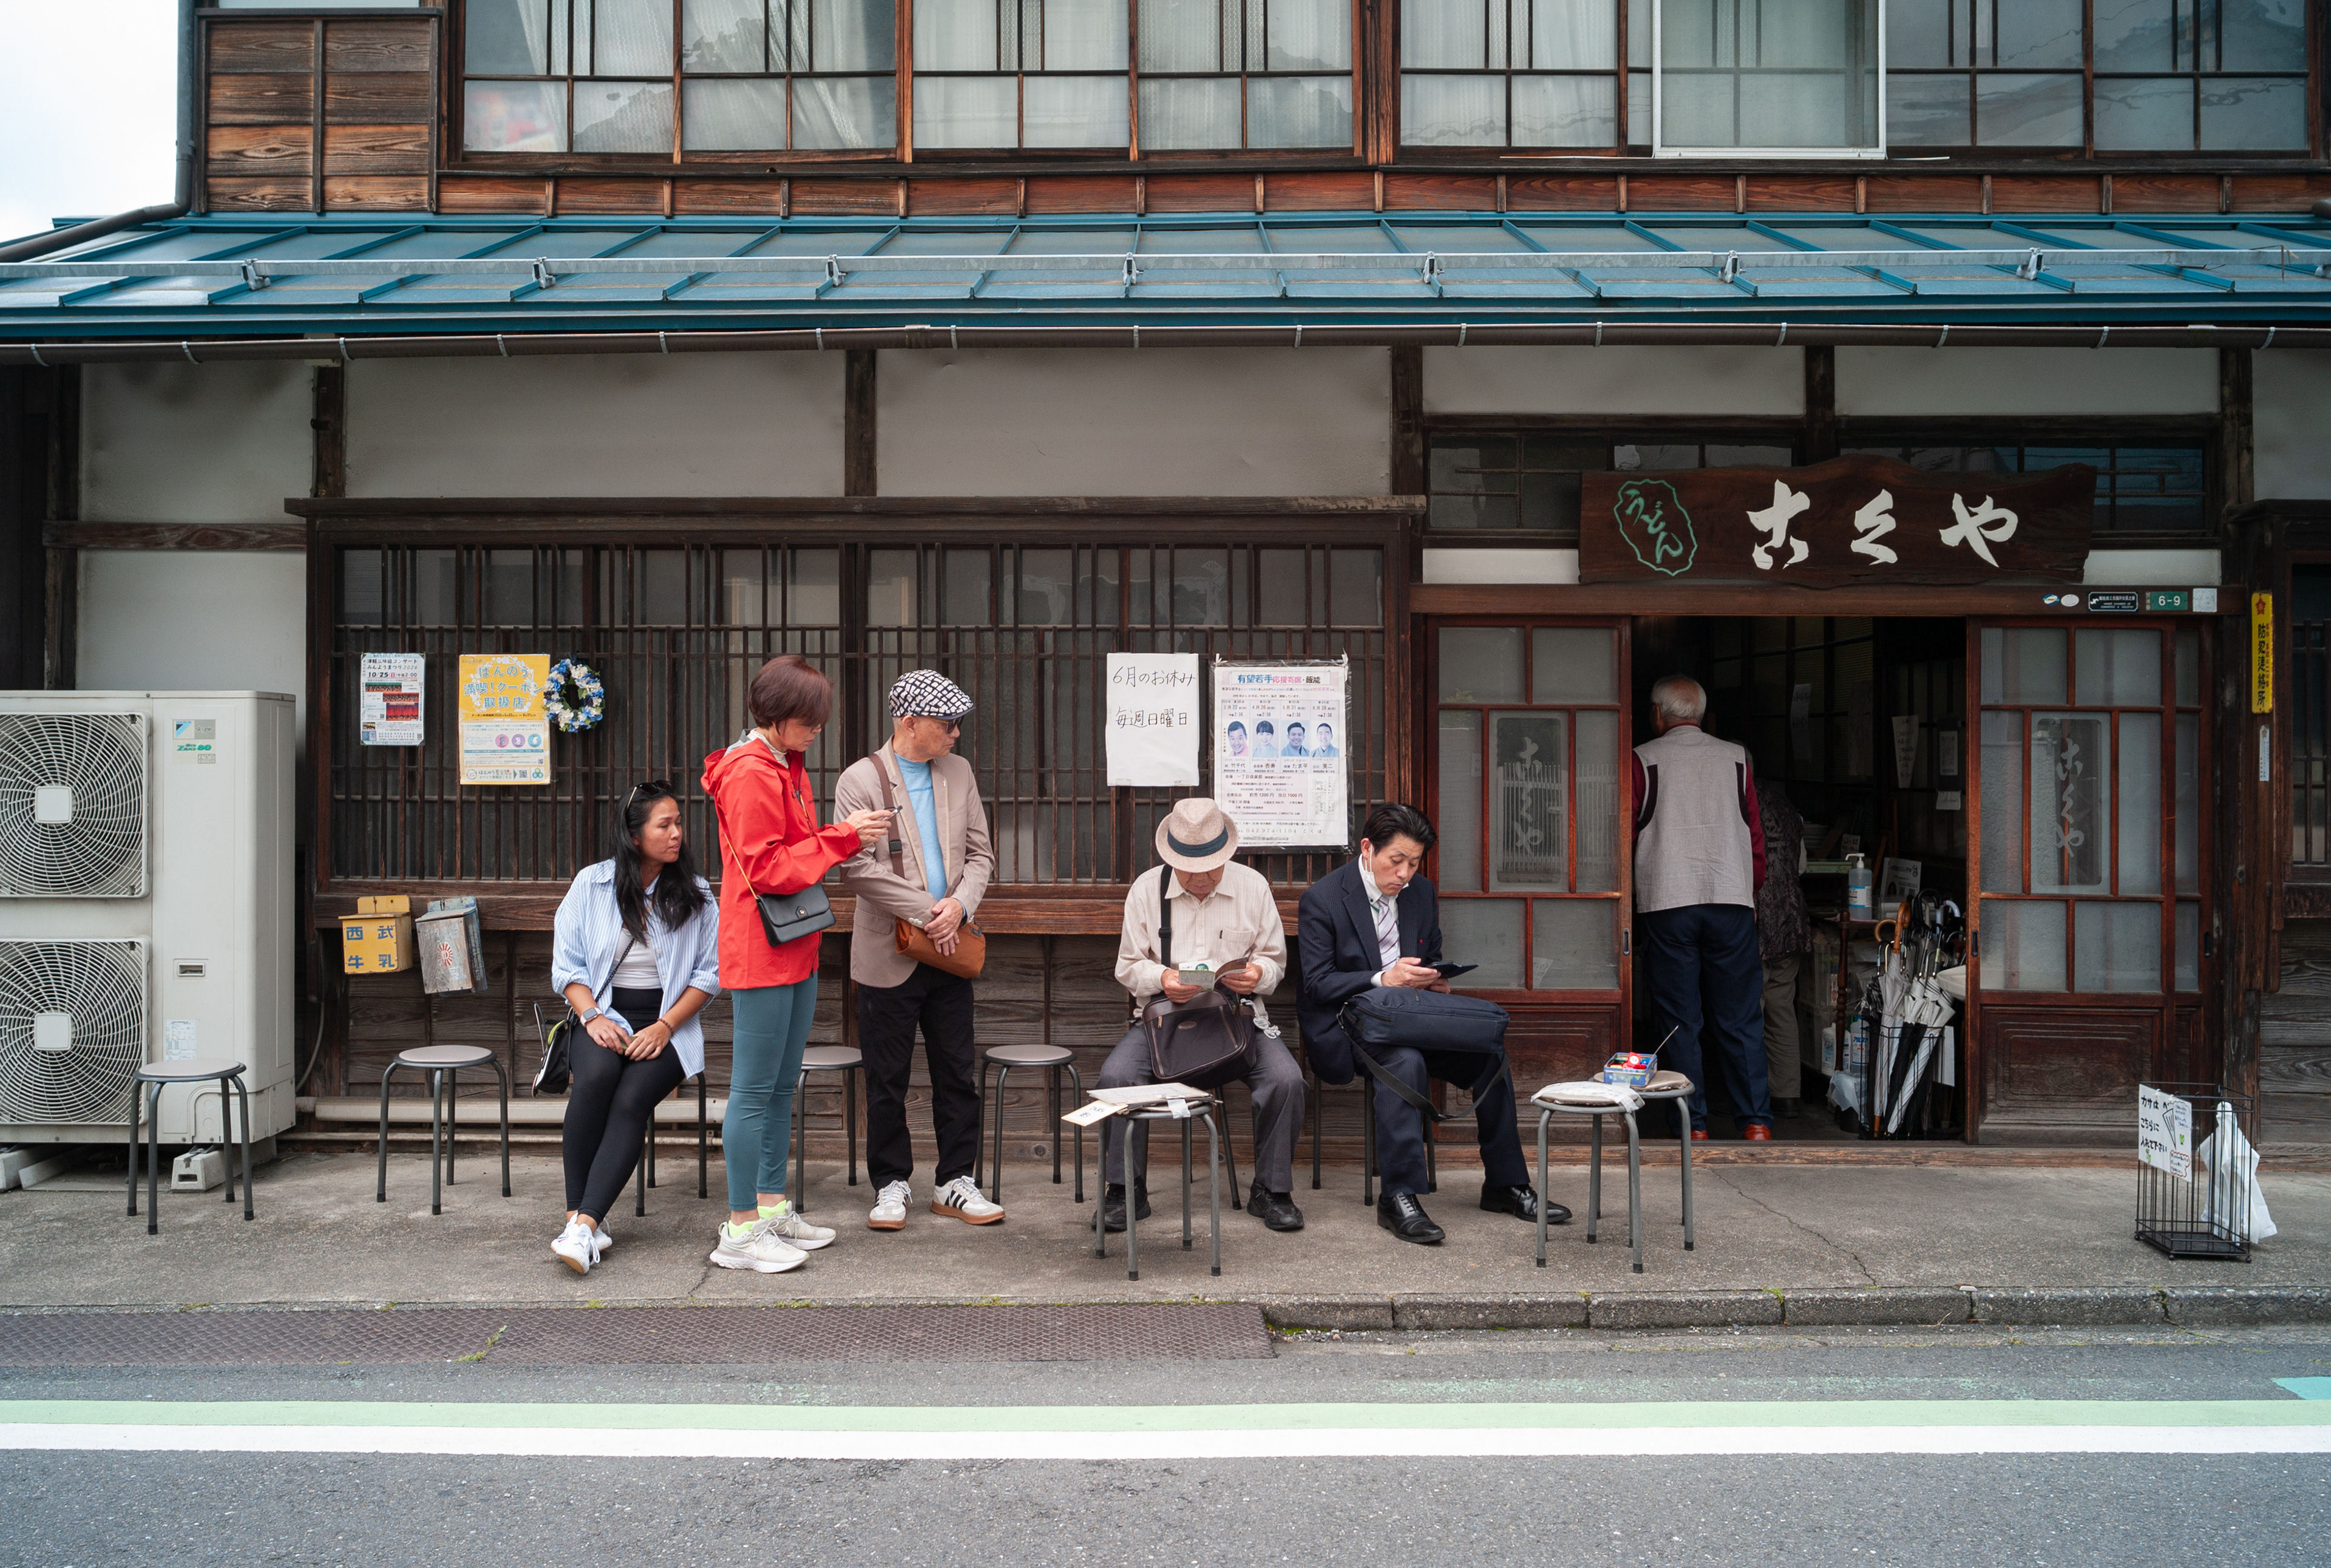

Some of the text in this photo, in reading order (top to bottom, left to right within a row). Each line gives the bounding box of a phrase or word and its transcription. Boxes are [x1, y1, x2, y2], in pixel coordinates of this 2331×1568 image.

[1624, 488, 1683, 564] うどん
[2159, 595, 2180, 606] 6-9
[478, 665, 528, 677] はんのう
[1113, 666, 1196, 687] 6月のお休み
[484, 696, 524, 708] 取扱店
[1115, 706, 1187, 728] 毎週日曜日
[346, 925, 396, 940] 西武
[347, 954, 395, 969] 牛乳
[2141, 1095, 2159, 1110] カサは
[2141, 1118, 2159, 1132] こちらに
[2140, 1135, 2167, 1152] 入れて下さい
